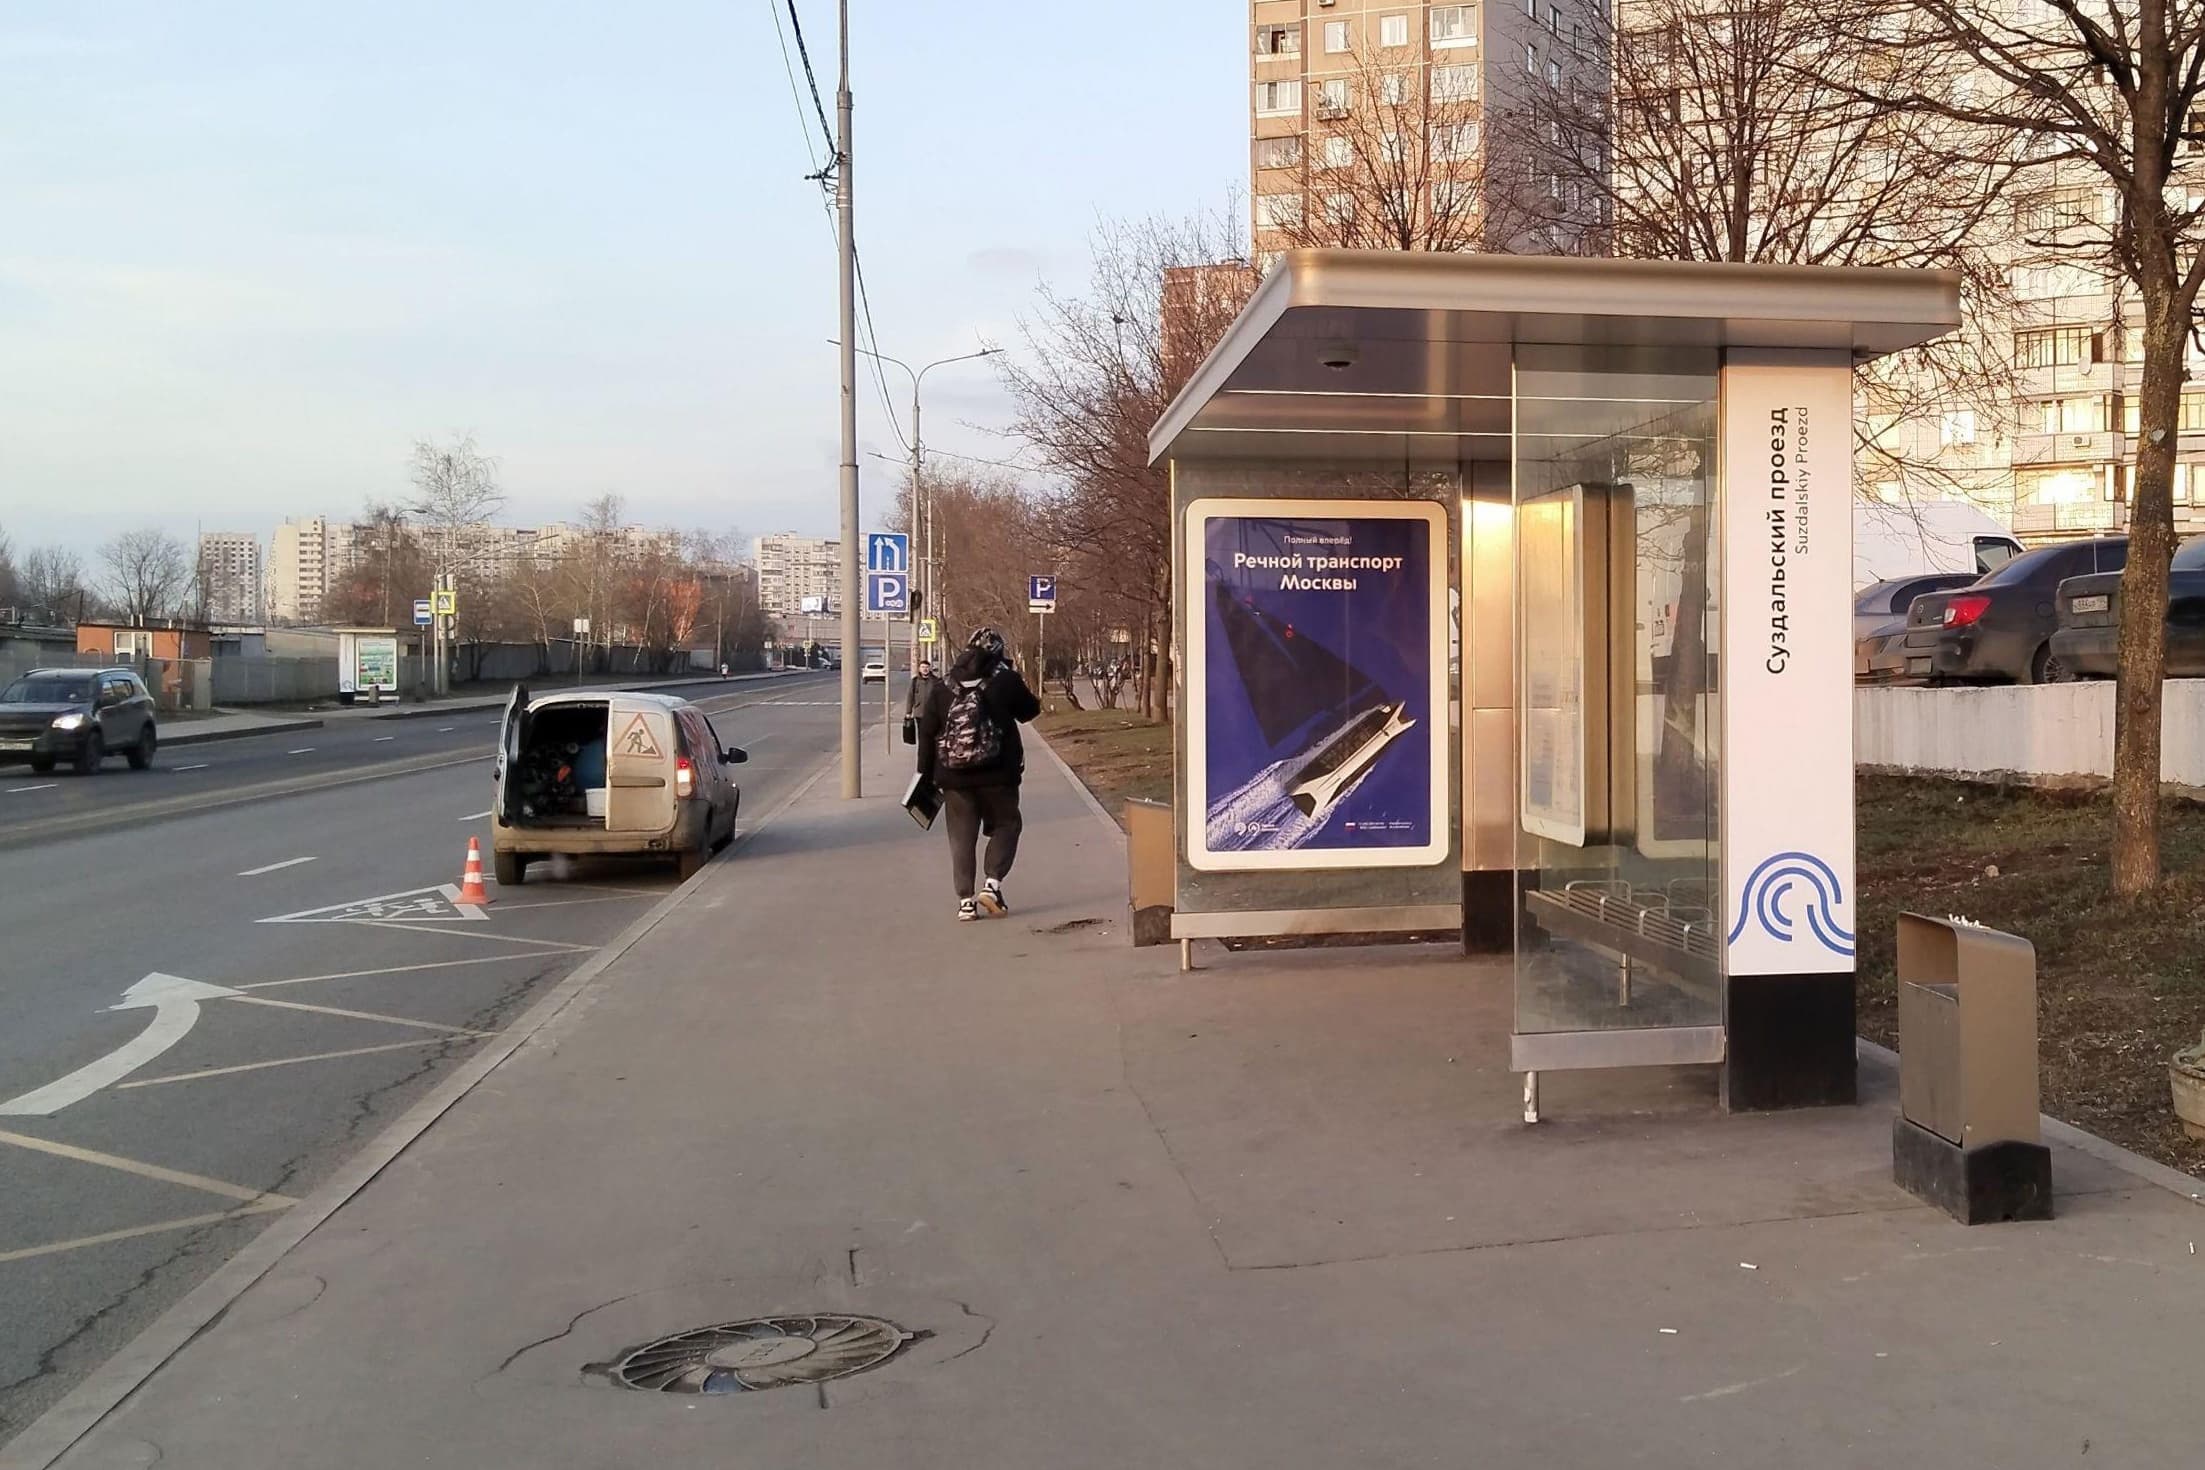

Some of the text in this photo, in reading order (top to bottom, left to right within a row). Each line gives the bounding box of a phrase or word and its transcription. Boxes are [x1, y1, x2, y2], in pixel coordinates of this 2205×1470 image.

[1795, 407, 1811, 555] Suzdalskiy Proezd
[1766, 407, 1790, 674] Суздальский проезд
[1234, 552, 1403, 573] Речной транспорт
[878, 577, 901, 608] P
[1036, 578, 1051, 598] P
[1280, 574, 1357, 590] Москвы
